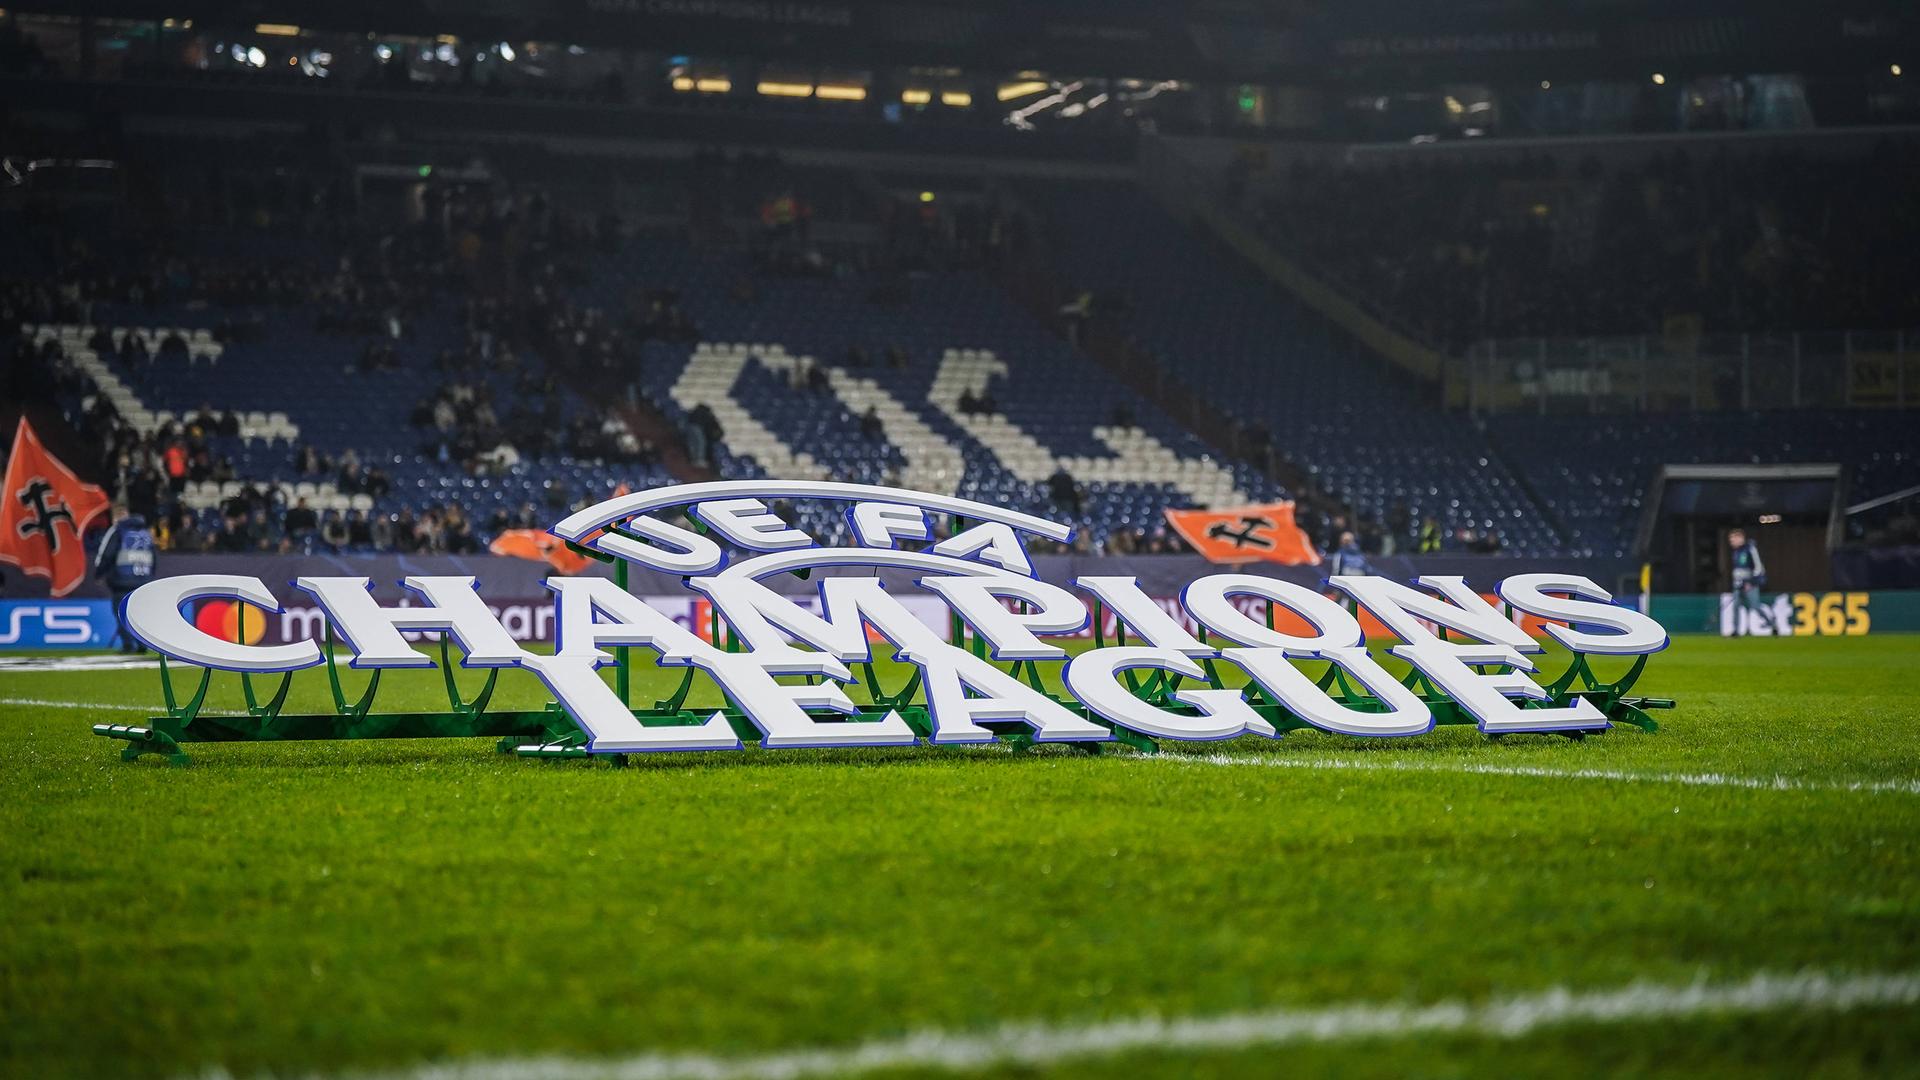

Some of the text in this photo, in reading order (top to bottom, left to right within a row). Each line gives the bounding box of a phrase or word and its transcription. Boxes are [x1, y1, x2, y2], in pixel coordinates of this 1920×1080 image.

[595, 498, 1040, 580] UEFA
[119, 573, 1670, 673] CHAMPIONS
[1720, 592, 1871, 636] bet365
[520, 646, 1613, 752] LEAGUE
